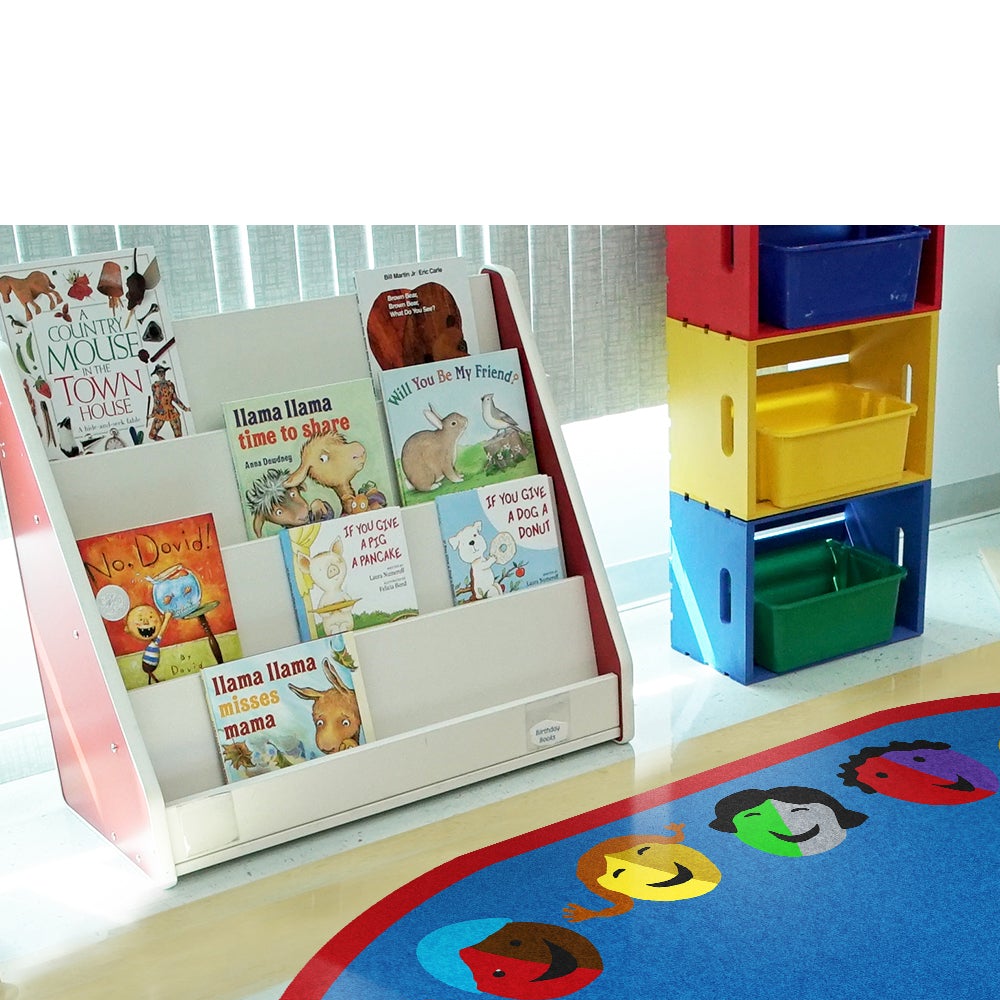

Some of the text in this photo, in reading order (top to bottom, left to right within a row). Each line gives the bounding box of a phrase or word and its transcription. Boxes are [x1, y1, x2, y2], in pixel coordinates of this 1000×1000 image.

[80, 309, 88, 320] A
[48, 316, 122, 342] COUNTRY
[48, 332, 140, 374] MOUSE
[82, 363, 111, 376] IN THE
[54, 370, 143, 406] TOWN
[388, 364, 519, 406] Will You Be My Friend?
[80, 398, 133, 421] HOUSE
[233, 397, 332, 428] llama llama
[238, 416, 350, 450] time to share
[245, 460, 262, 470] Anna
[486, 486, 547, 509] IF YOU GIVE
[508, 503, 548, 524] A DOG A
[343, 517, 400, 538] IF YOU GIVE
[518, 520, 550, 539] DONUT
[361, 534, 387, 550] A PIG
[352, 547, 402, 568] A PANCAKE
[211, 657, 317, 696] llama llama
[218, 690, 280, 718] misses
[223, 714, 277, 740] mama
